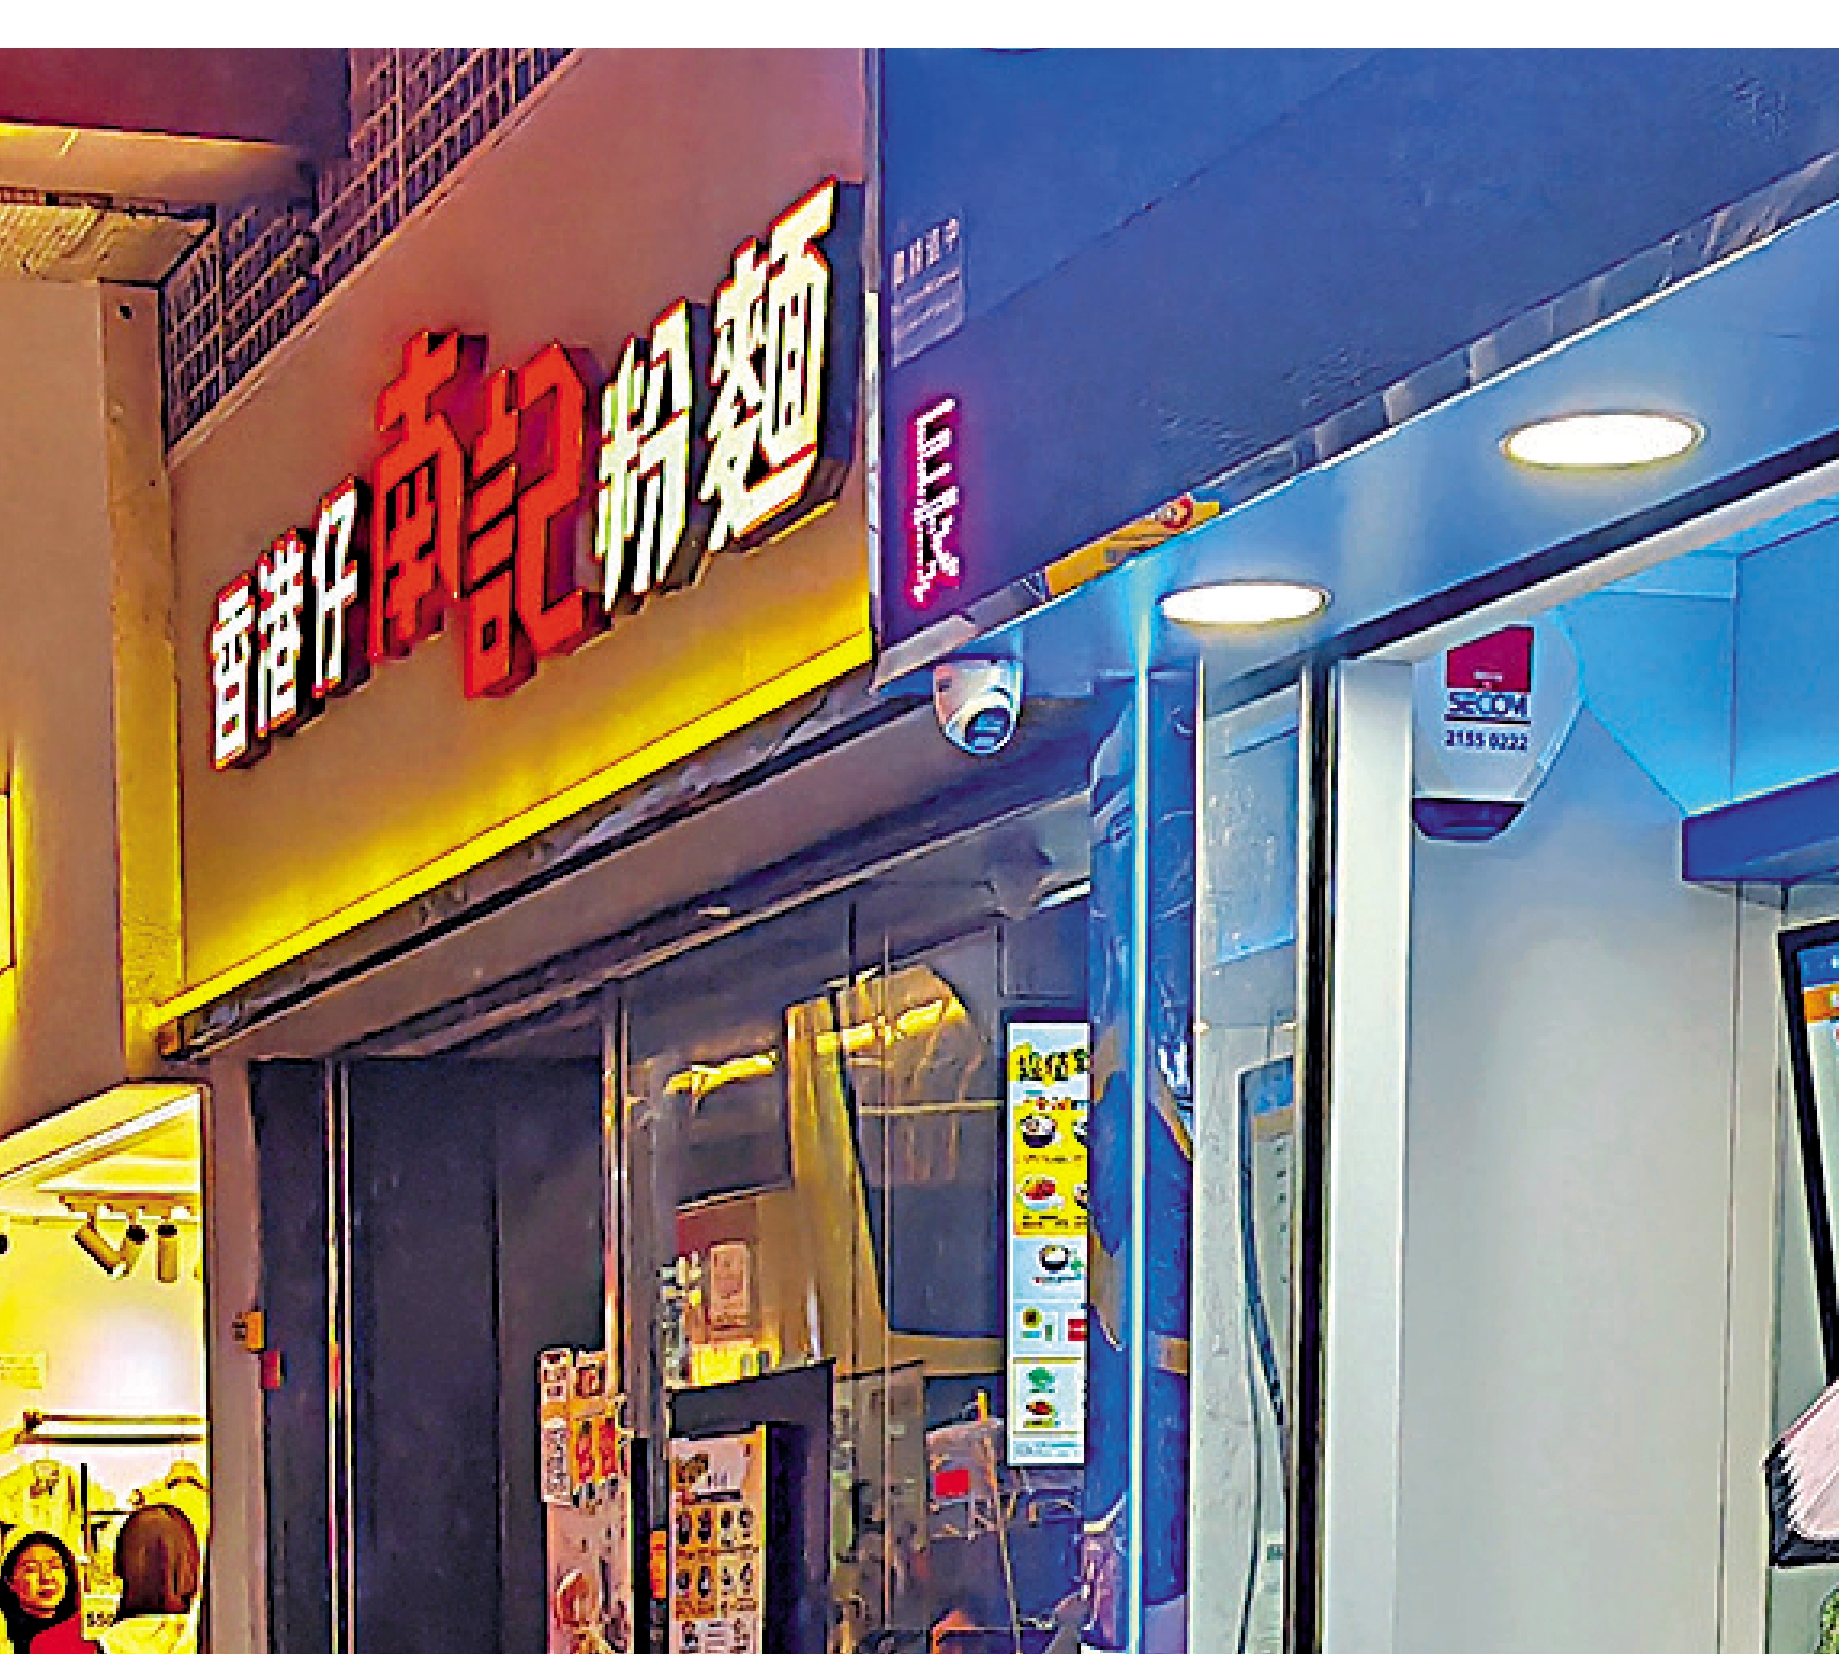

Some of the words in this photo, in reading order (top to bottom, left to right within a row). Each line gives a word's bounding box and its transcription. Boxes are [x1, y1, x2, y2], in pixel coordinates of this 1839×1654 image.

[210, 174, 839, 770] 香港仔南記粉麵
[1449, 691, 1528, 717] SECOM
